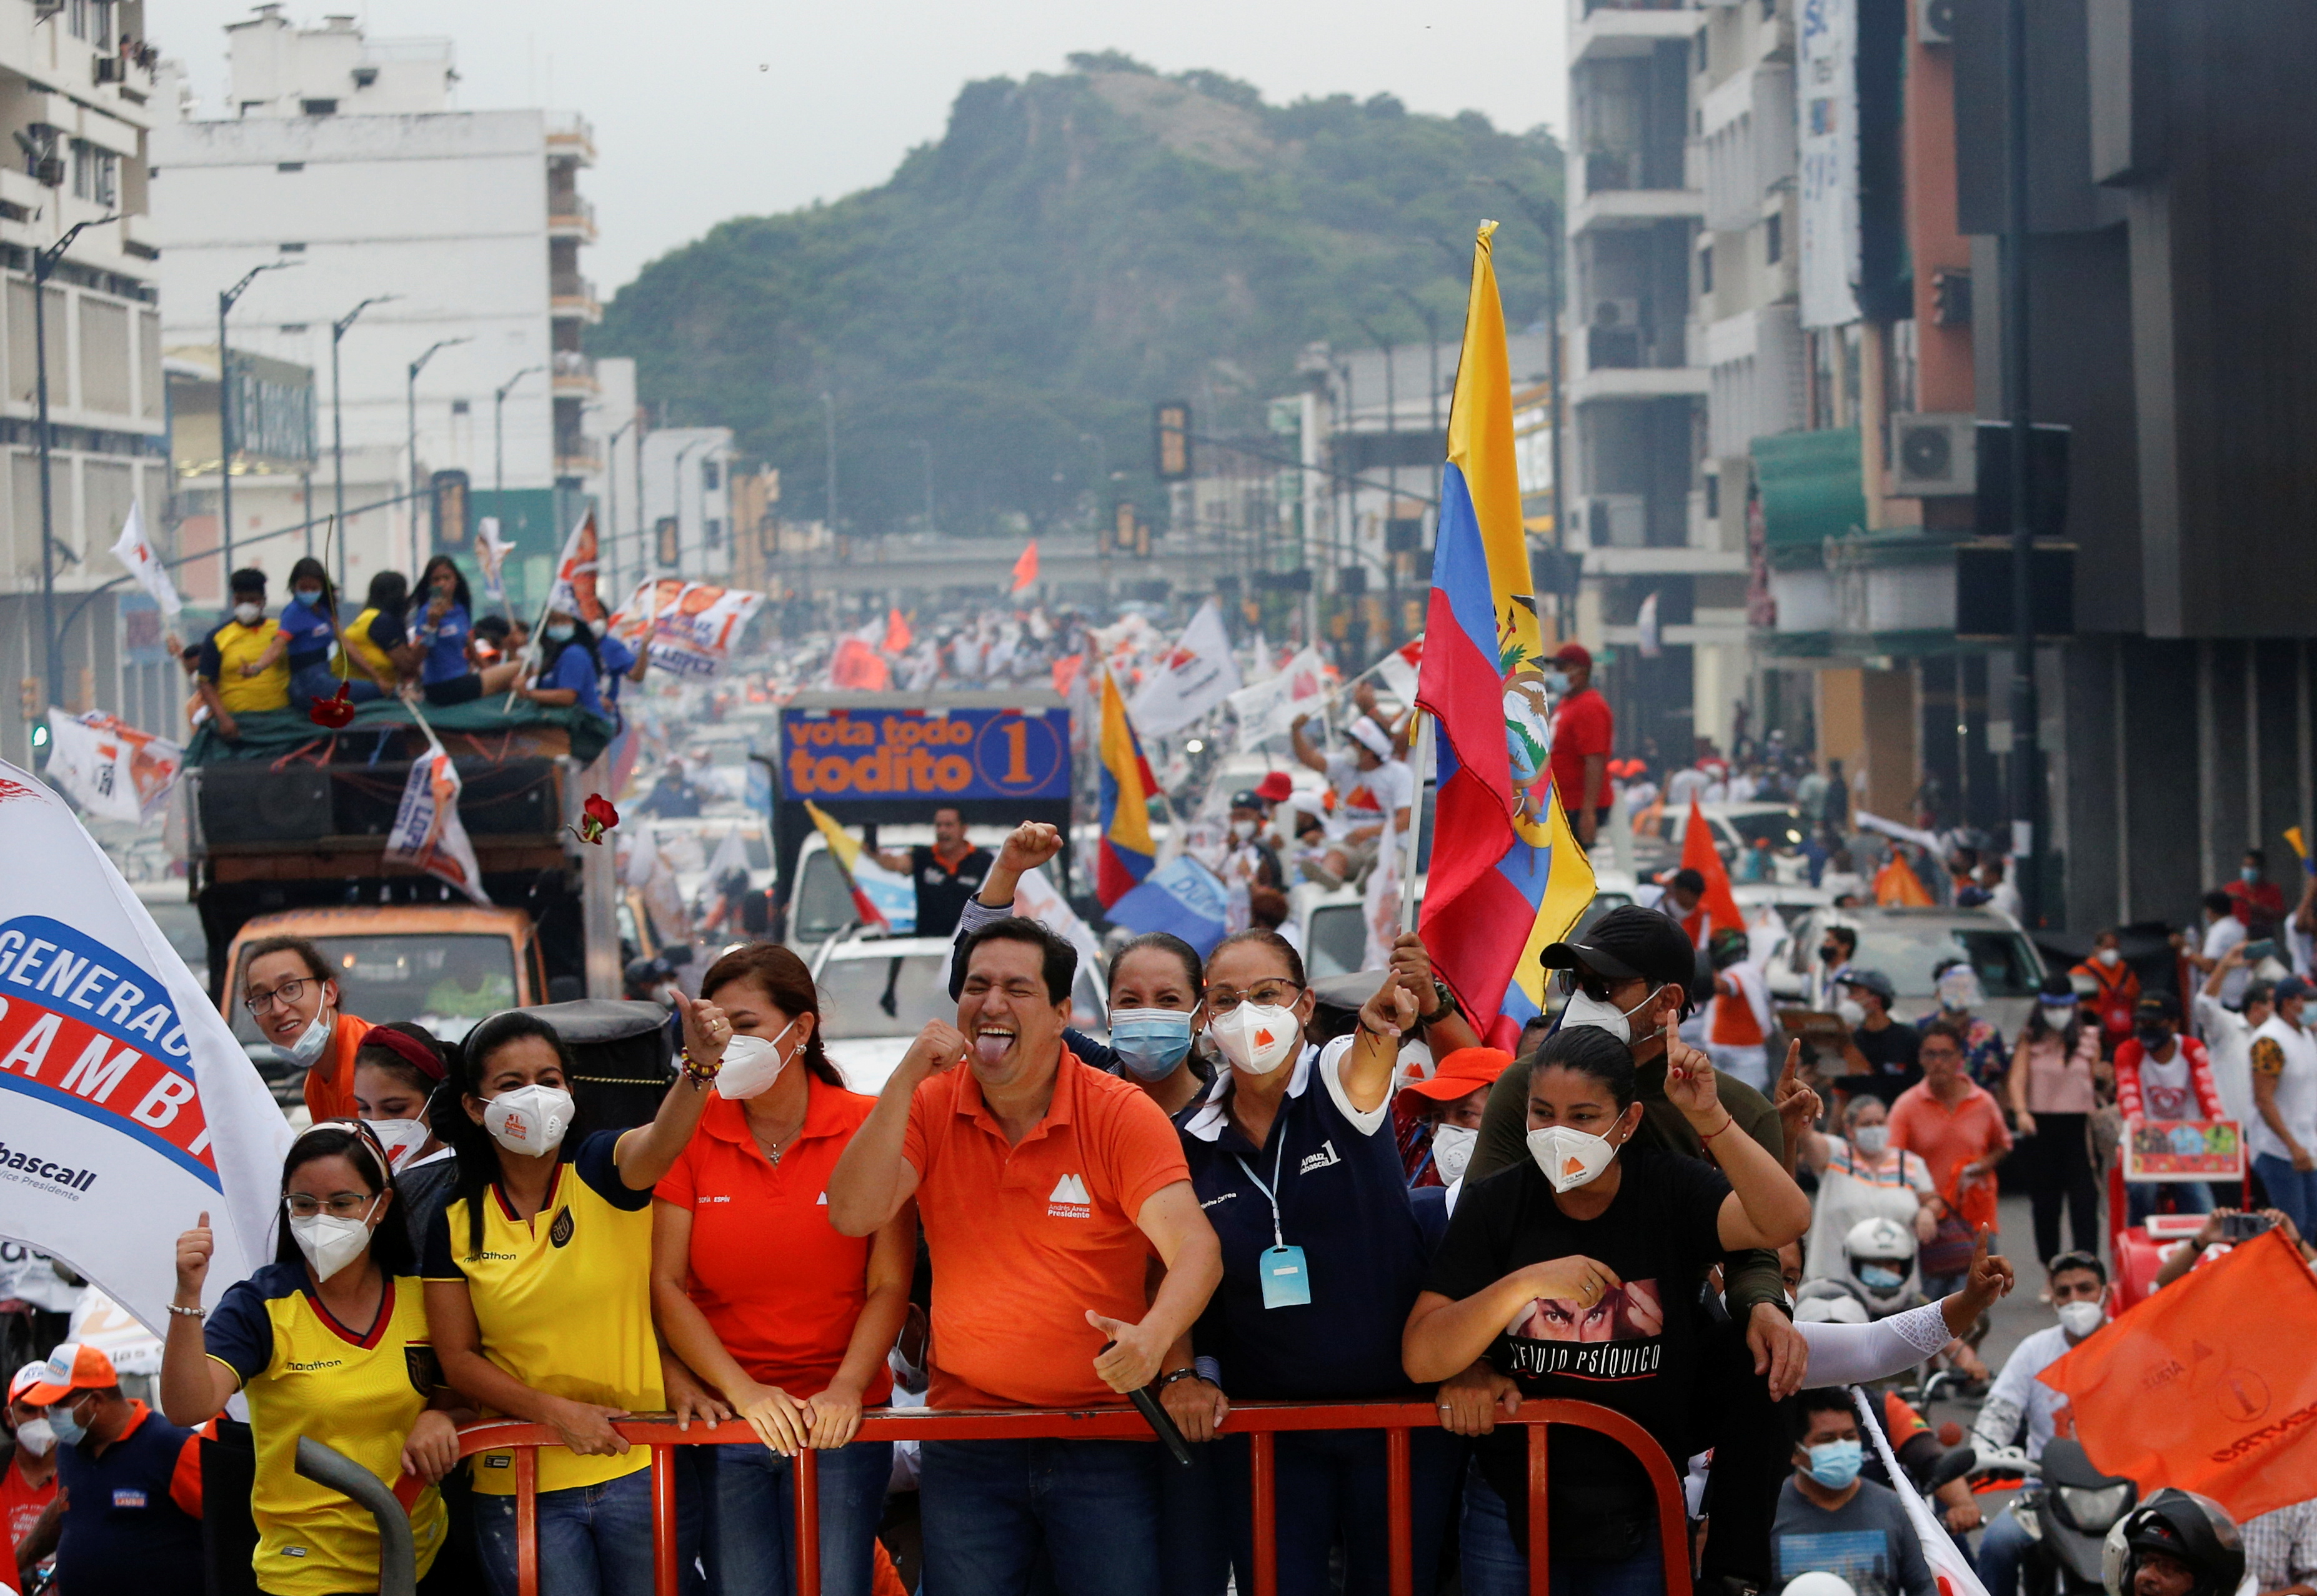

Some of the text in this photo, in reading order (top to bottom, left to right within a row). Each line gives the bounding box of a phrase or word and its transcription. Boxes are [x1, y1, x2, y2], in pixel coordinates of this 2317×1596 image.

[789, 715, 974, 746] vota todo
[1002, 719, 1033, 783] 1
[787, 744, 974, 793] todito
[1321, 1139, 1341, 1167] 1
[21, 1175, 80, 1202] Presidente
[1048, 1209, 1090, 1219] Presidente
[1049, 1204, 1070, 1212] Andrés
[1576, 1344, 1660, 1377] PSÍQUICO
